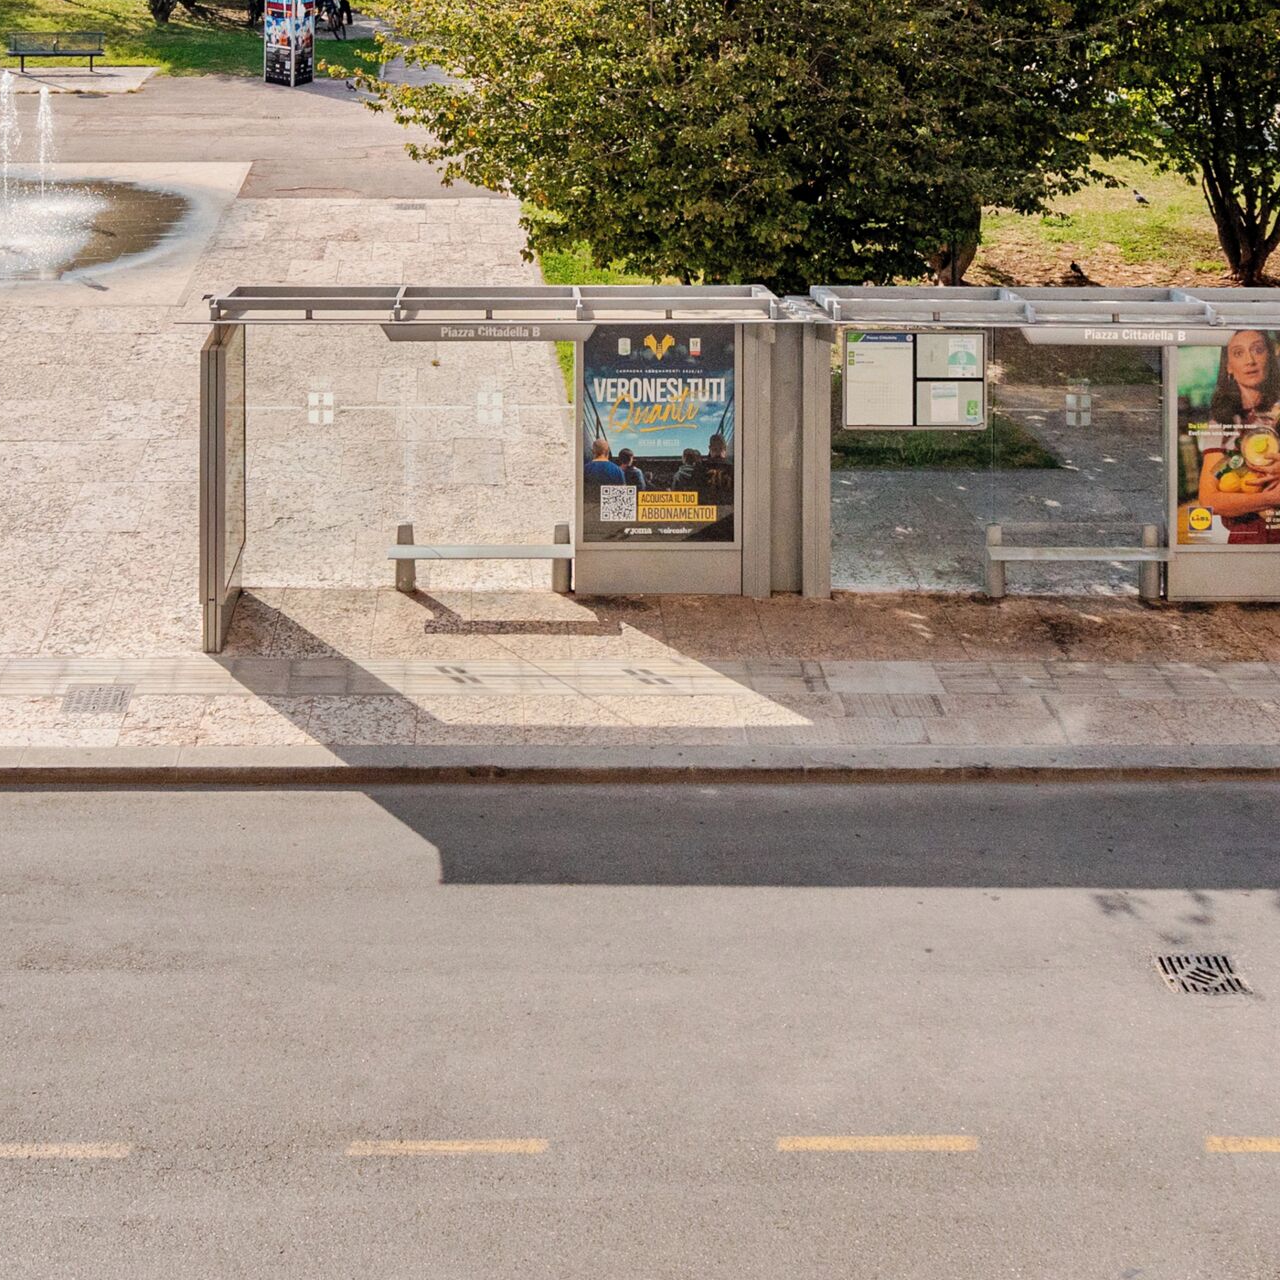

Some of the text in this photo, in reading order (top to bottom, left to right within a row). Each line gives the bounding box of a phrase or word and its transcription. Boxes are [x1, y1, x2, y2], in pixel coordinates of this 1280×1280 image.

[440, 326, 541, 338] Piazza Cittadella B
[1084, 328, 1186, 341] Piazza Cittadella B
[593, 377, 726, 403] VERONESI TUTI
[608, 386, 699, 433] Quanti
[640, 493, 696, 504] ACQUISTA IL TUO
[640, 507, 715, 520] ABBONAMENTO!
